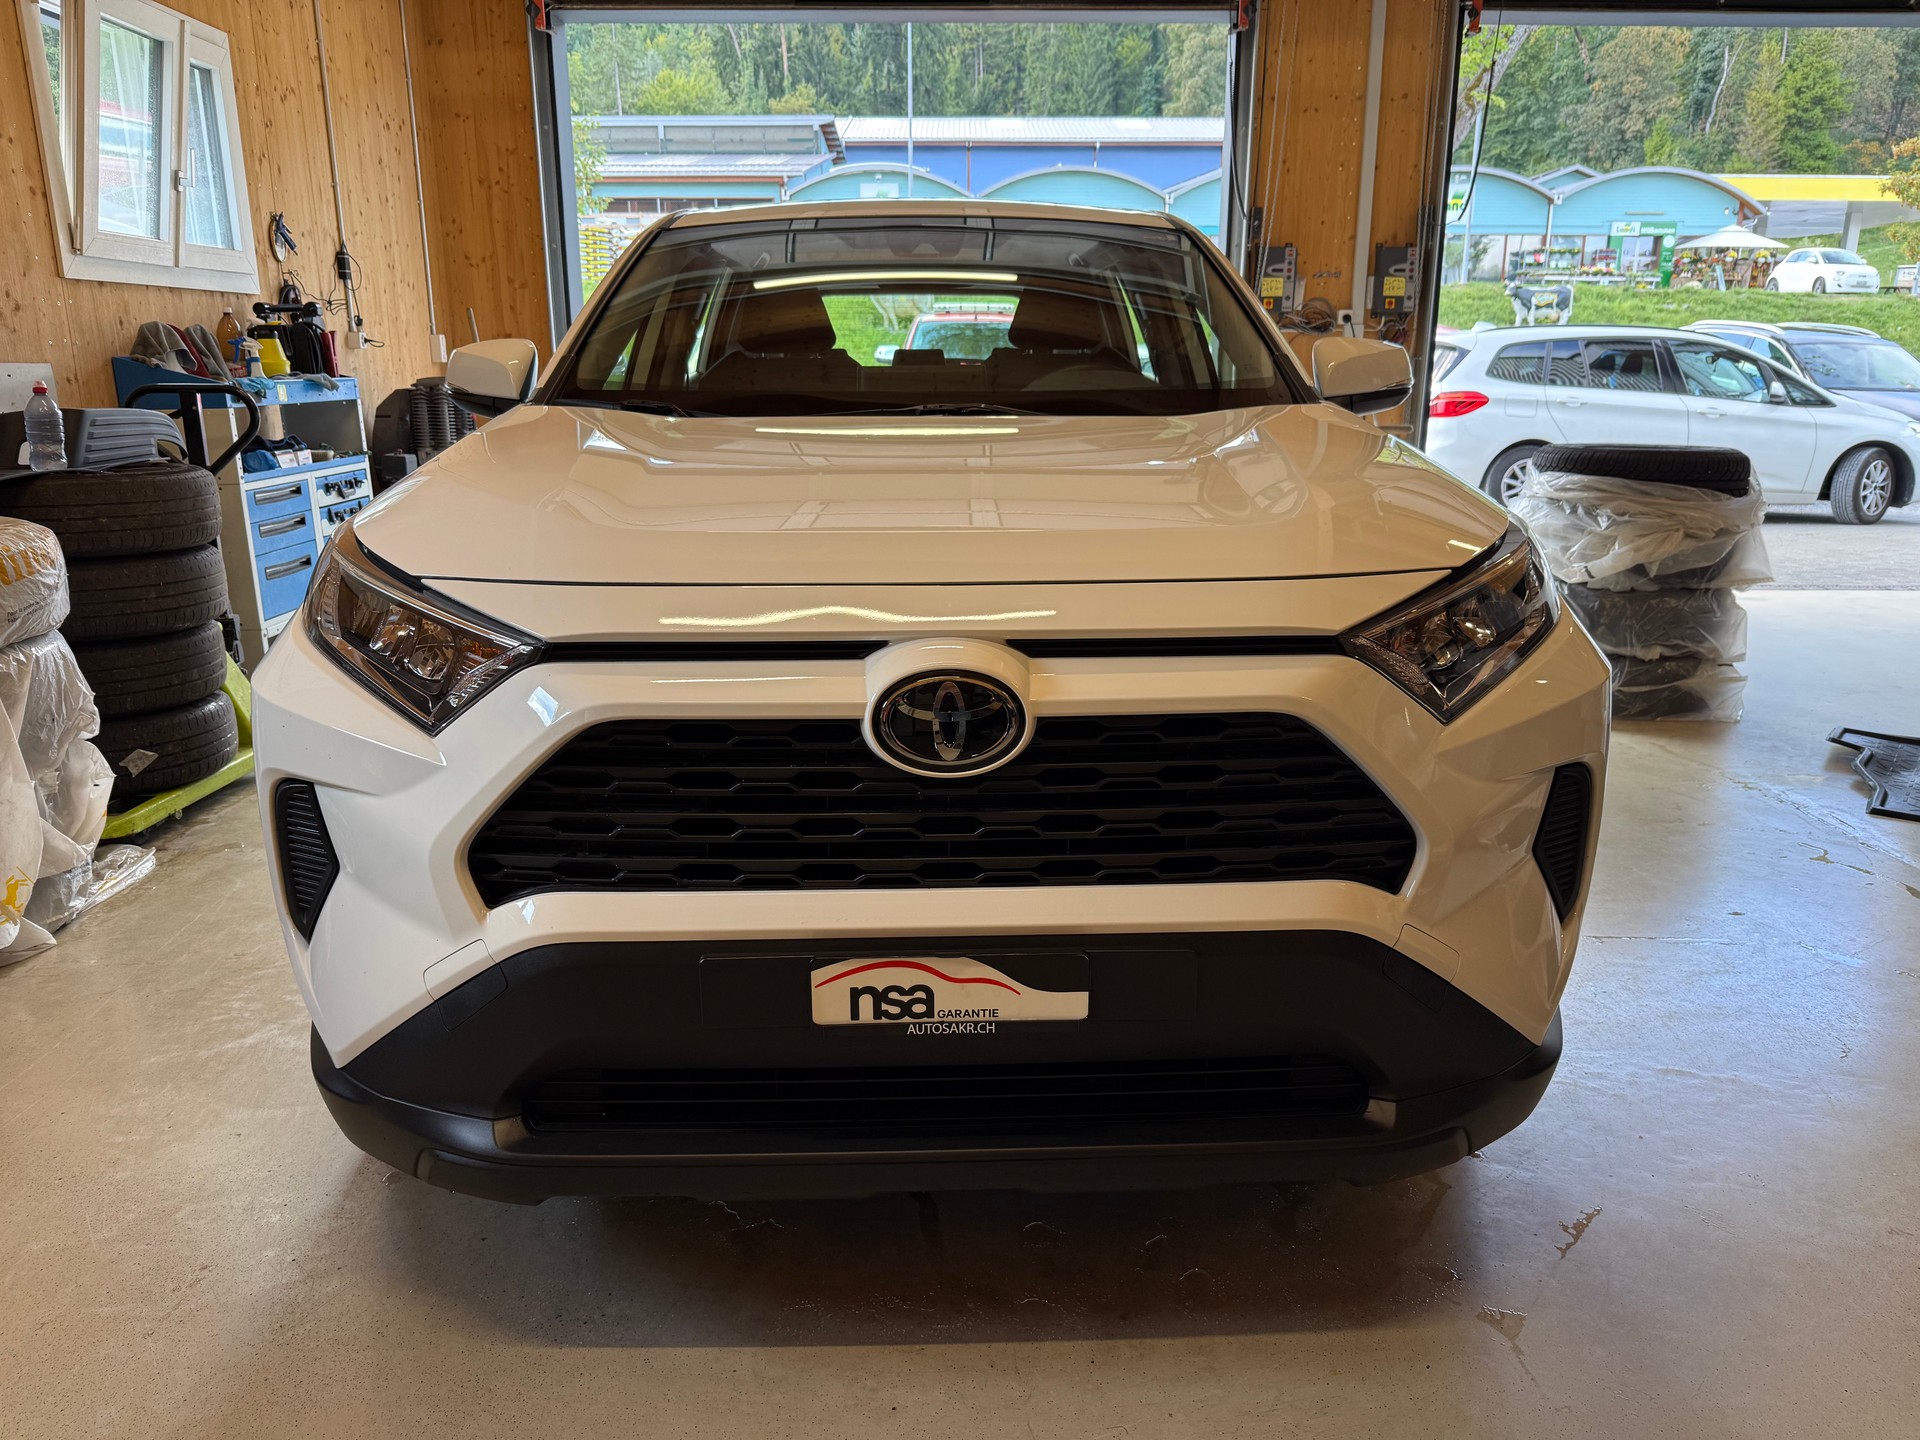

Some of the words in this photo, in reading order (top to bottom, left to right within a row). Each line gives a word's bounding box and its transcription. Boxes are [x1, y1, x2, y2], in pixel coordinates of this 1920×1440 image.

[850, 984, 935, 1021] nsa
[937, 1008, 999, 1019] GARANTIE
[907, 1022, 995, 1035] AUTOSAKR.CH
